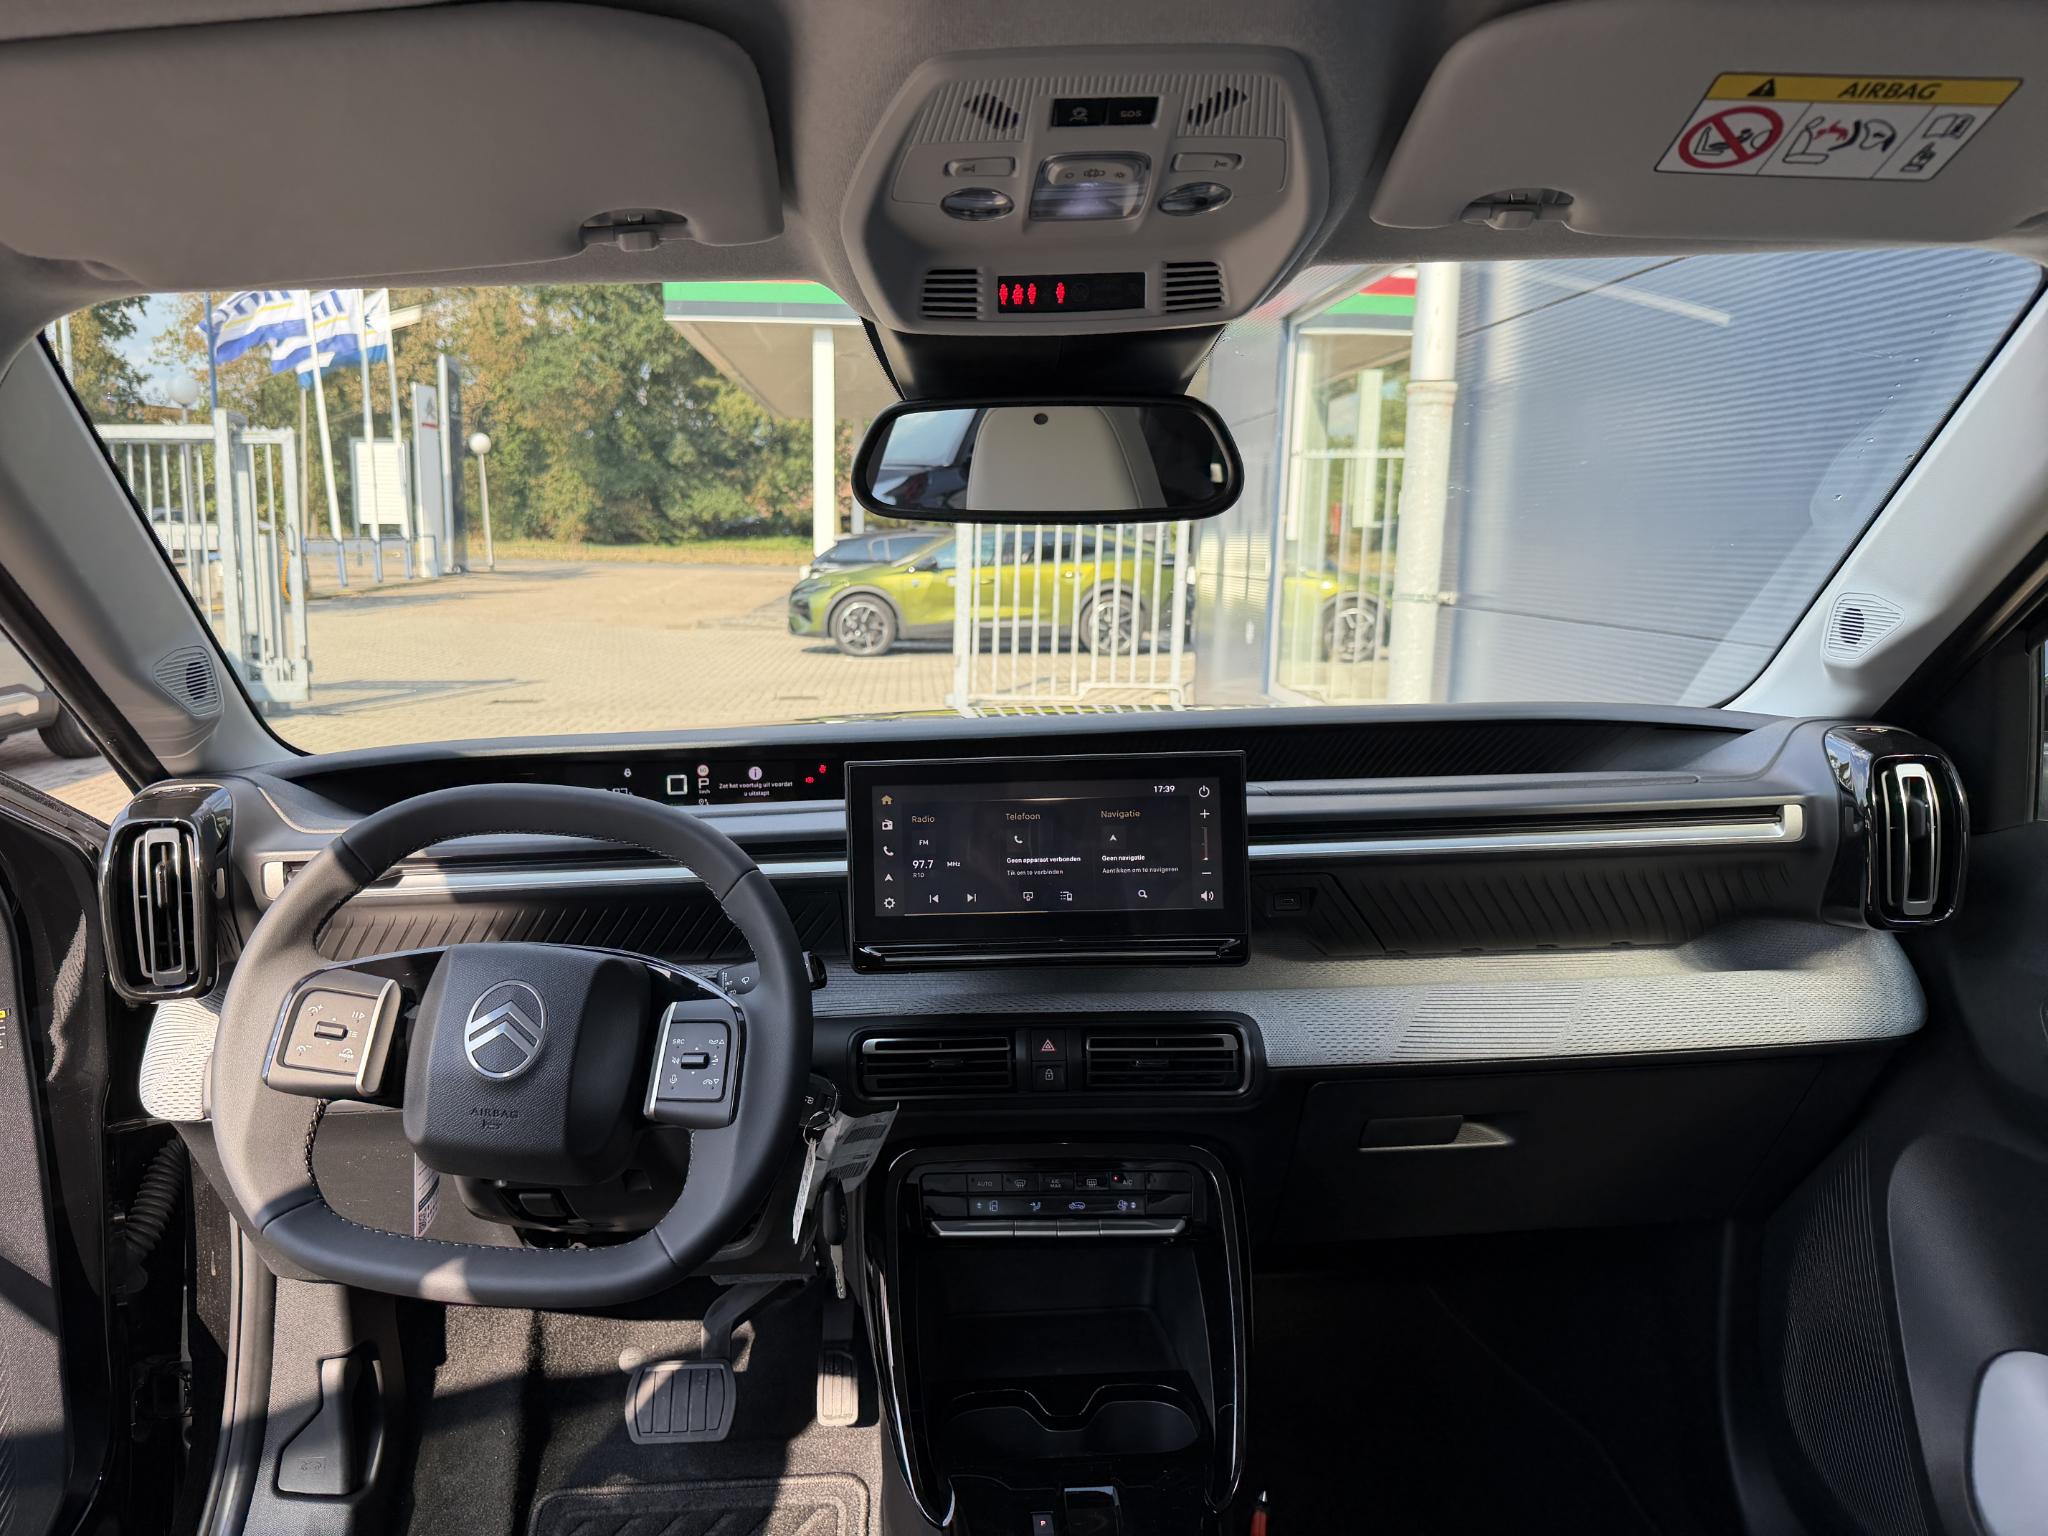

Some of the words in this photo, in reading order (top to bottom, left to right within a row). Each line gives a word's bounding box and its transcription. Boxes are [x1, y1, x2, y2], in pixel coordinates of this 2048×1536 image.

[1837, 82, 1942, 100] AIRBAG
[1120, 110, 1142, 118] SOS
[698, 777, 710, 789] P
[1153, 785, 1176, 793] 17:39
[749, 790, 770, 798] uitstapt
[911, 815, 935, 823] Radio
[1006, 812, 1041, 821] Telefoon
[1100, 810, 1141, 820] Navigatie
[1118, 854, 1145, 862] navigatie
[912, 859, 934, 869] 97.7
[1149, 866, 1179, 874] navigeren
[470, 1107, 520, 1119] AIRBAG
